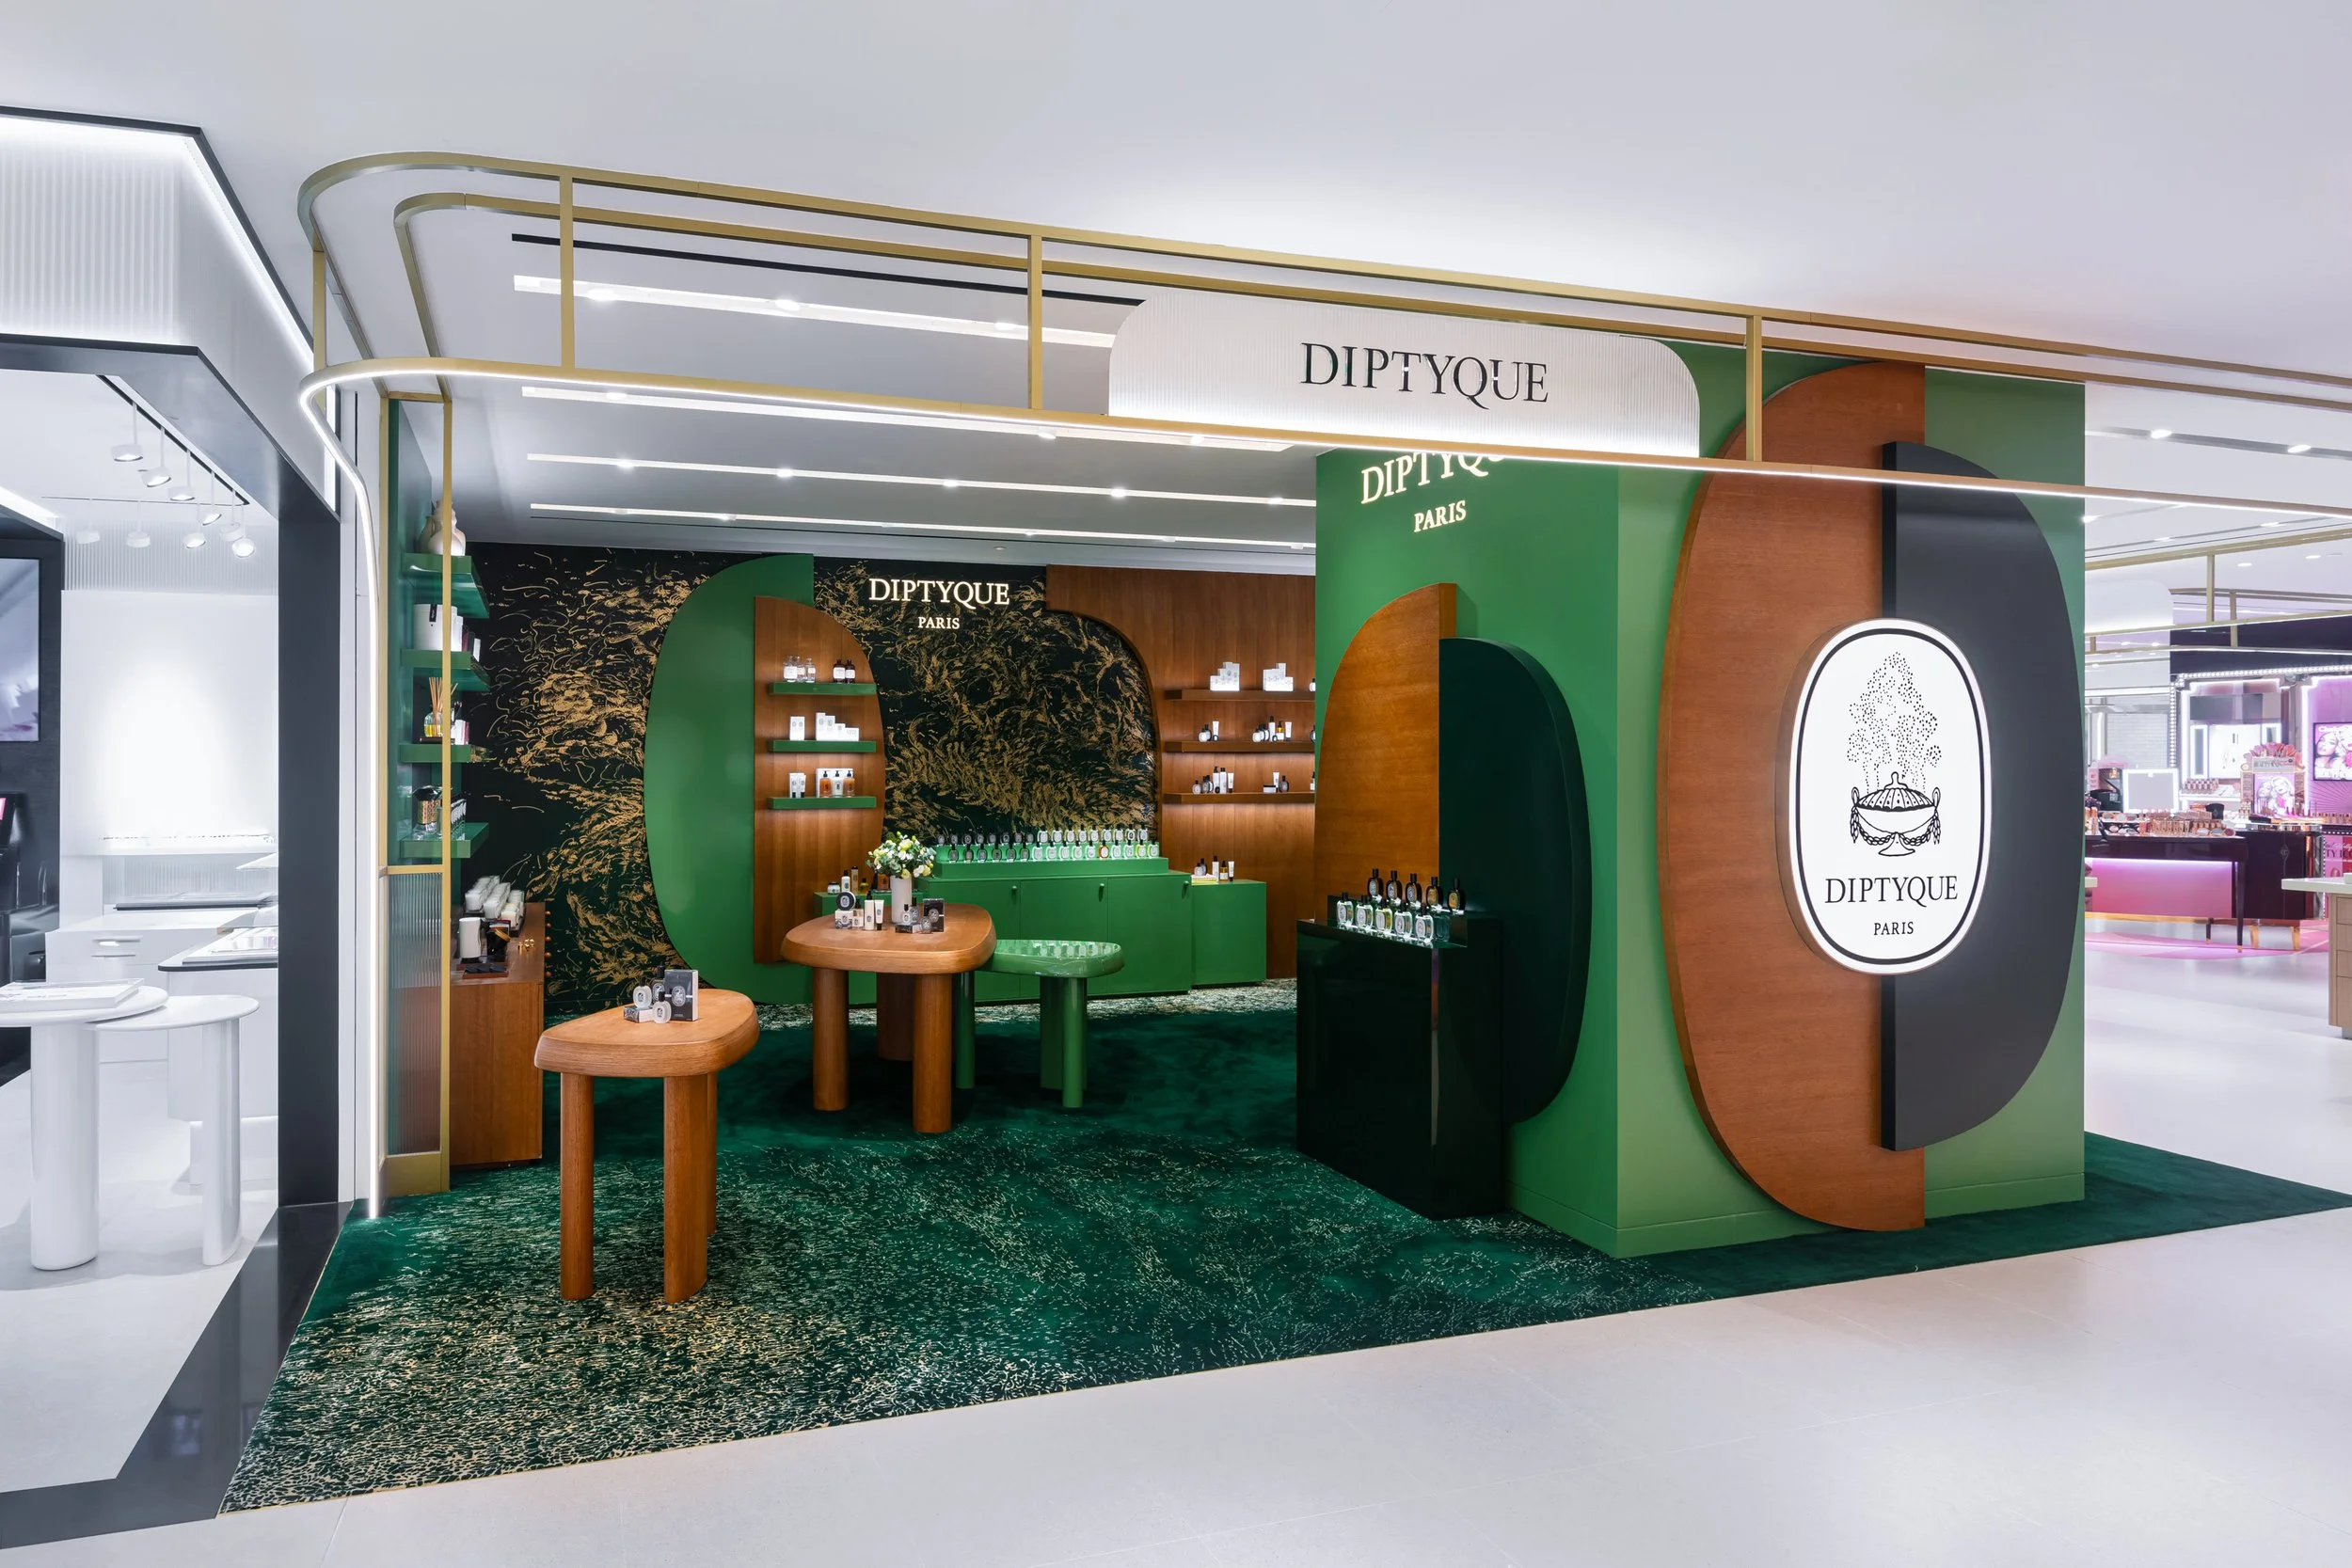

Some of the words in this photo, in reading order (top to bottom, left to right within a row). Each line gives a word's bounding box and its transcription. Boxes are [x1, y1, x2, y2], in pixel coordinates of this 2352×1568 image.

[1300, 342, 1549, 410] DIPTYQUE
[1360, 451, 1506, 504] DIPTYQ
[1413, 499, 1467, 532] PARIS
[868, 578, 1010, 610] DIPTYQUE
[917, 616, 961, 629] PARIS
[1824, 876, 1958, 908] DIPTYQUE
[1873, 921, 1915, 936] PARIS
